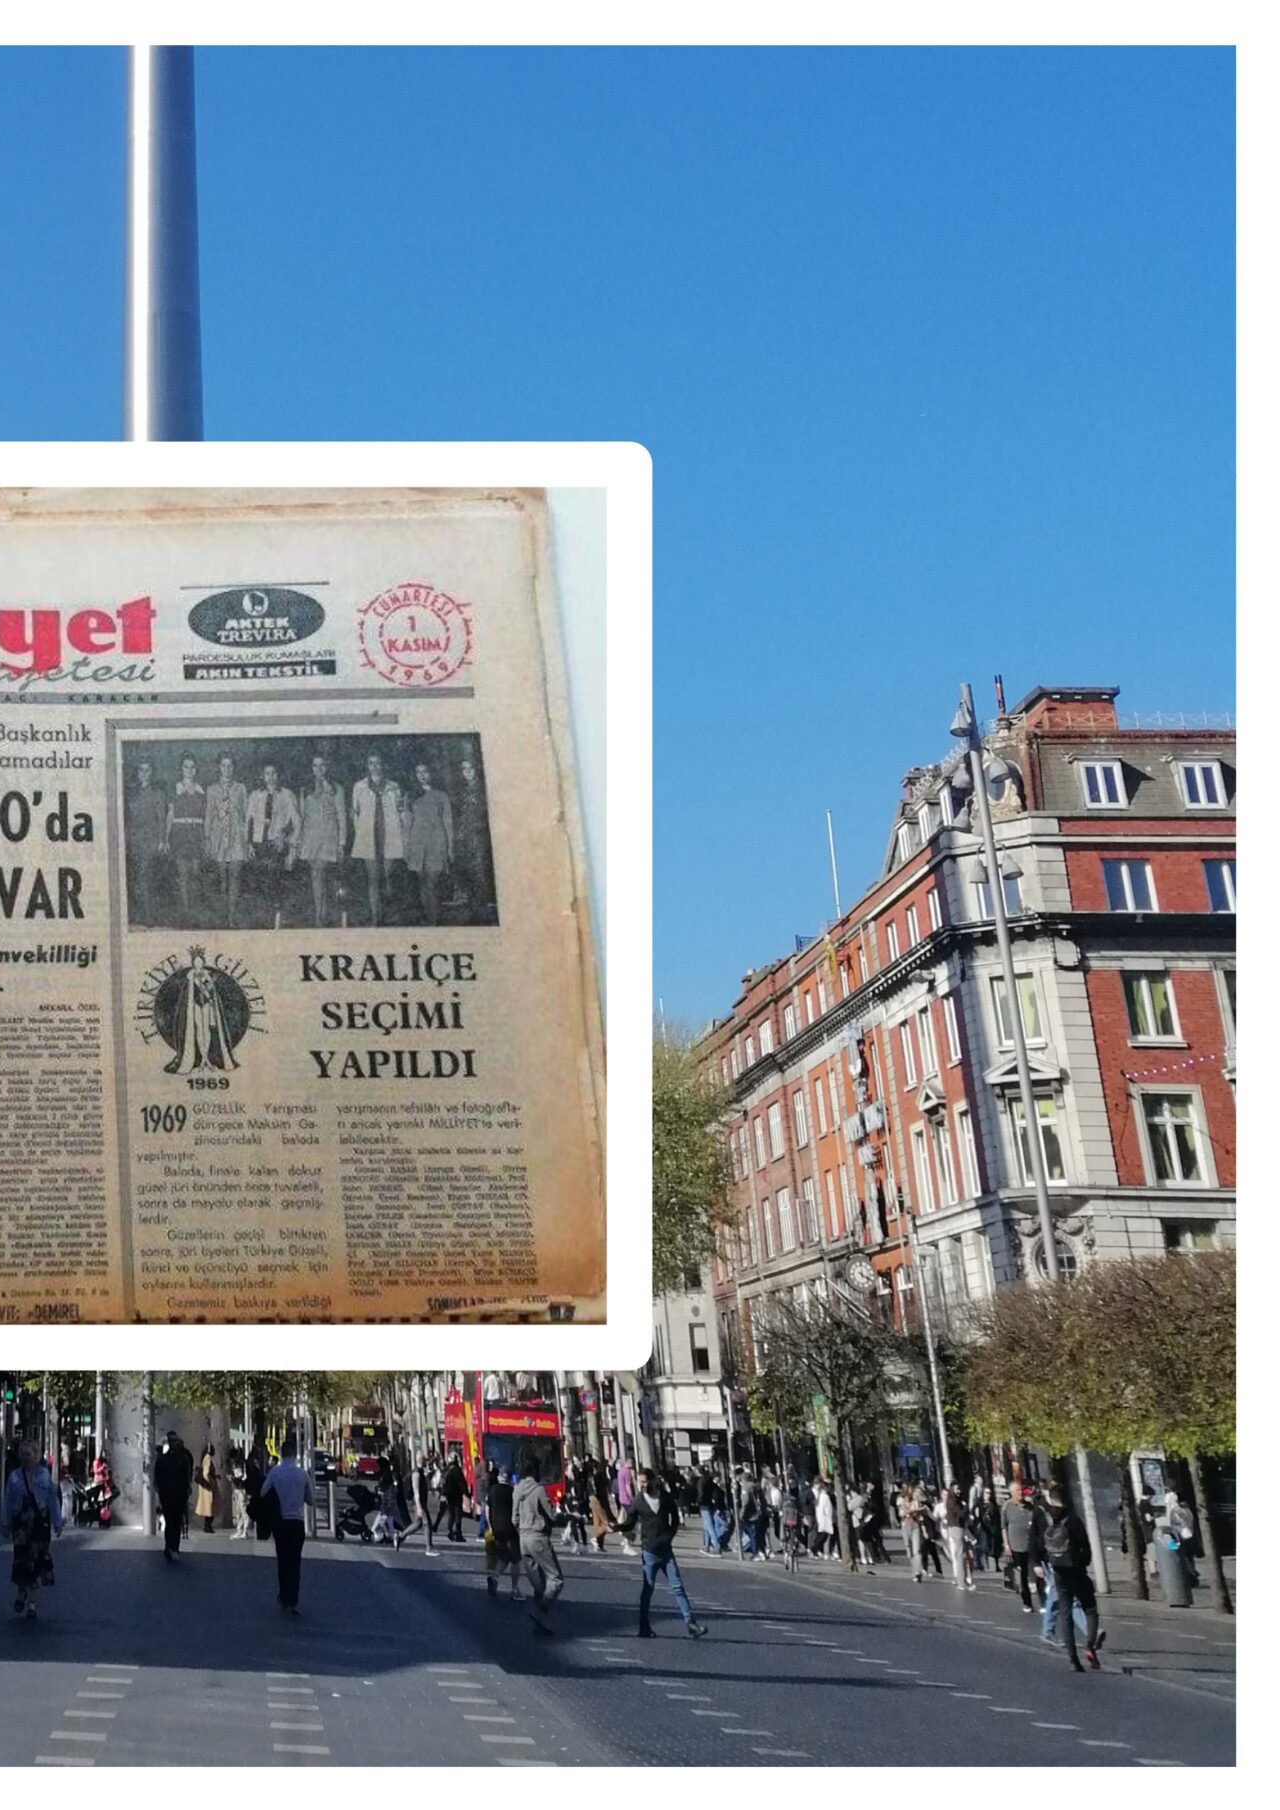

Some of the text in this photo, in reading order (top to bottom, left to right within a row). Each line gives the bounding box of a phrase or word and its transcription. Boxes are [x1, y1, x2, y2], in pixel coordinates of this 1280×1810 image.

[225, 616, 290, 630] AKTEK
[407, 615, 417, 633] 1
[387, 637, 442, 653] KASIM
[195, 662, 321, 680] AKIN TEKSTİL
[388, 662, 450, 681] 1969
[299, 943, 477, 986] KRALİÇE
[322, 991, 465, 1036] SEÇİMİ
[310, 1049, 478, 1080] YAPILDI
[186, 1076, 230, 1090] 1969
[140, 1103, 187, 1133] 1969
[219, 1121, 244, 1133] gece
[163, 1165, 205, 1178] Baloda,
[249, 1164, 280, 1177] kalan
[287, 1163, 323, 1177] dokuz
[137, 1199, 168, 1209] sonra
[172, 1198, 188, 1209] da
[236, 1197, 272, 1209] olarak
[243, 1244, 285, 1259] Türkiye
[176, 1263, 190, 1273] ve
[257, 1261, 300, 1276] seçmek
